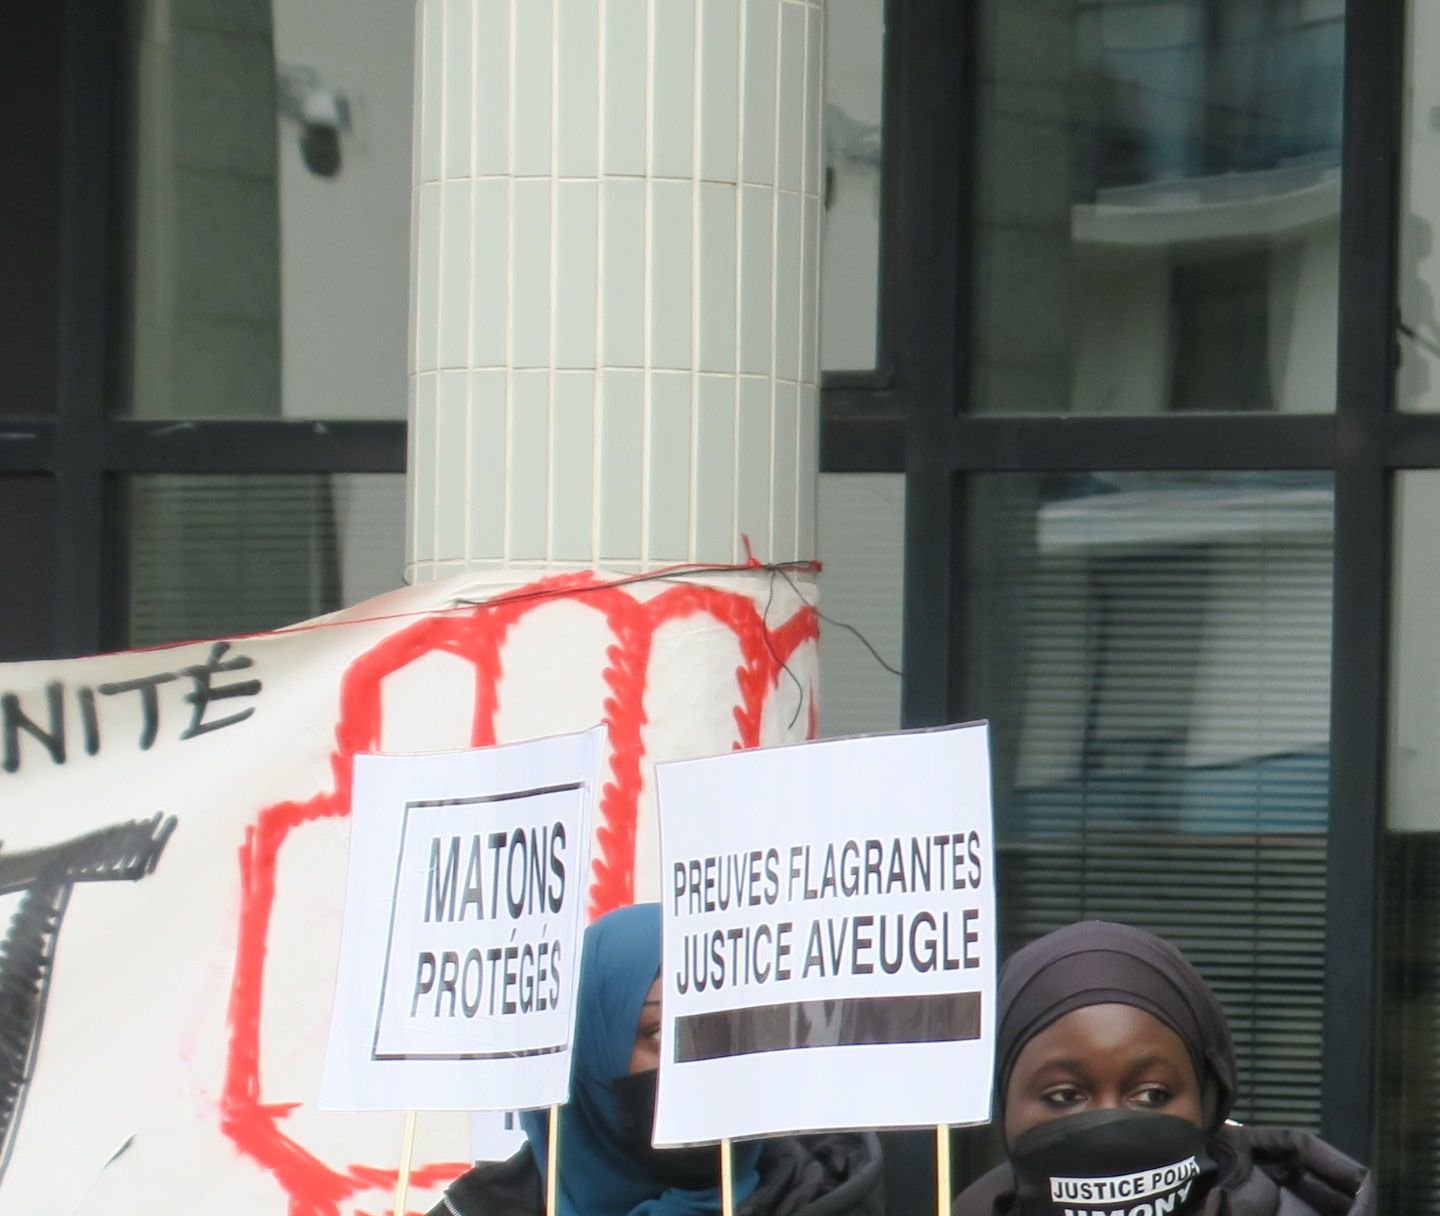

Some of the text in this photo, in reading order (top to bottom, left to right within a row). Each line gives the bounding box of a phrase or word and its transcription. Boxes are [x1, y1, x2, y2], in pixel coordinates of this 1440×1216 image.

[2, 641, 262, 773] NITÉ
[424, 821, 566, 923] MATONS
[674, 830, 982, 916] PREUVES FLAGRANTES
[409, 924, 561, 1018] PROTÉGÉS
[676, 908, 981, 995] JUSTICE AVEUGLE
[1054, 1161, 1199, 1200] JUSTICE POUR
